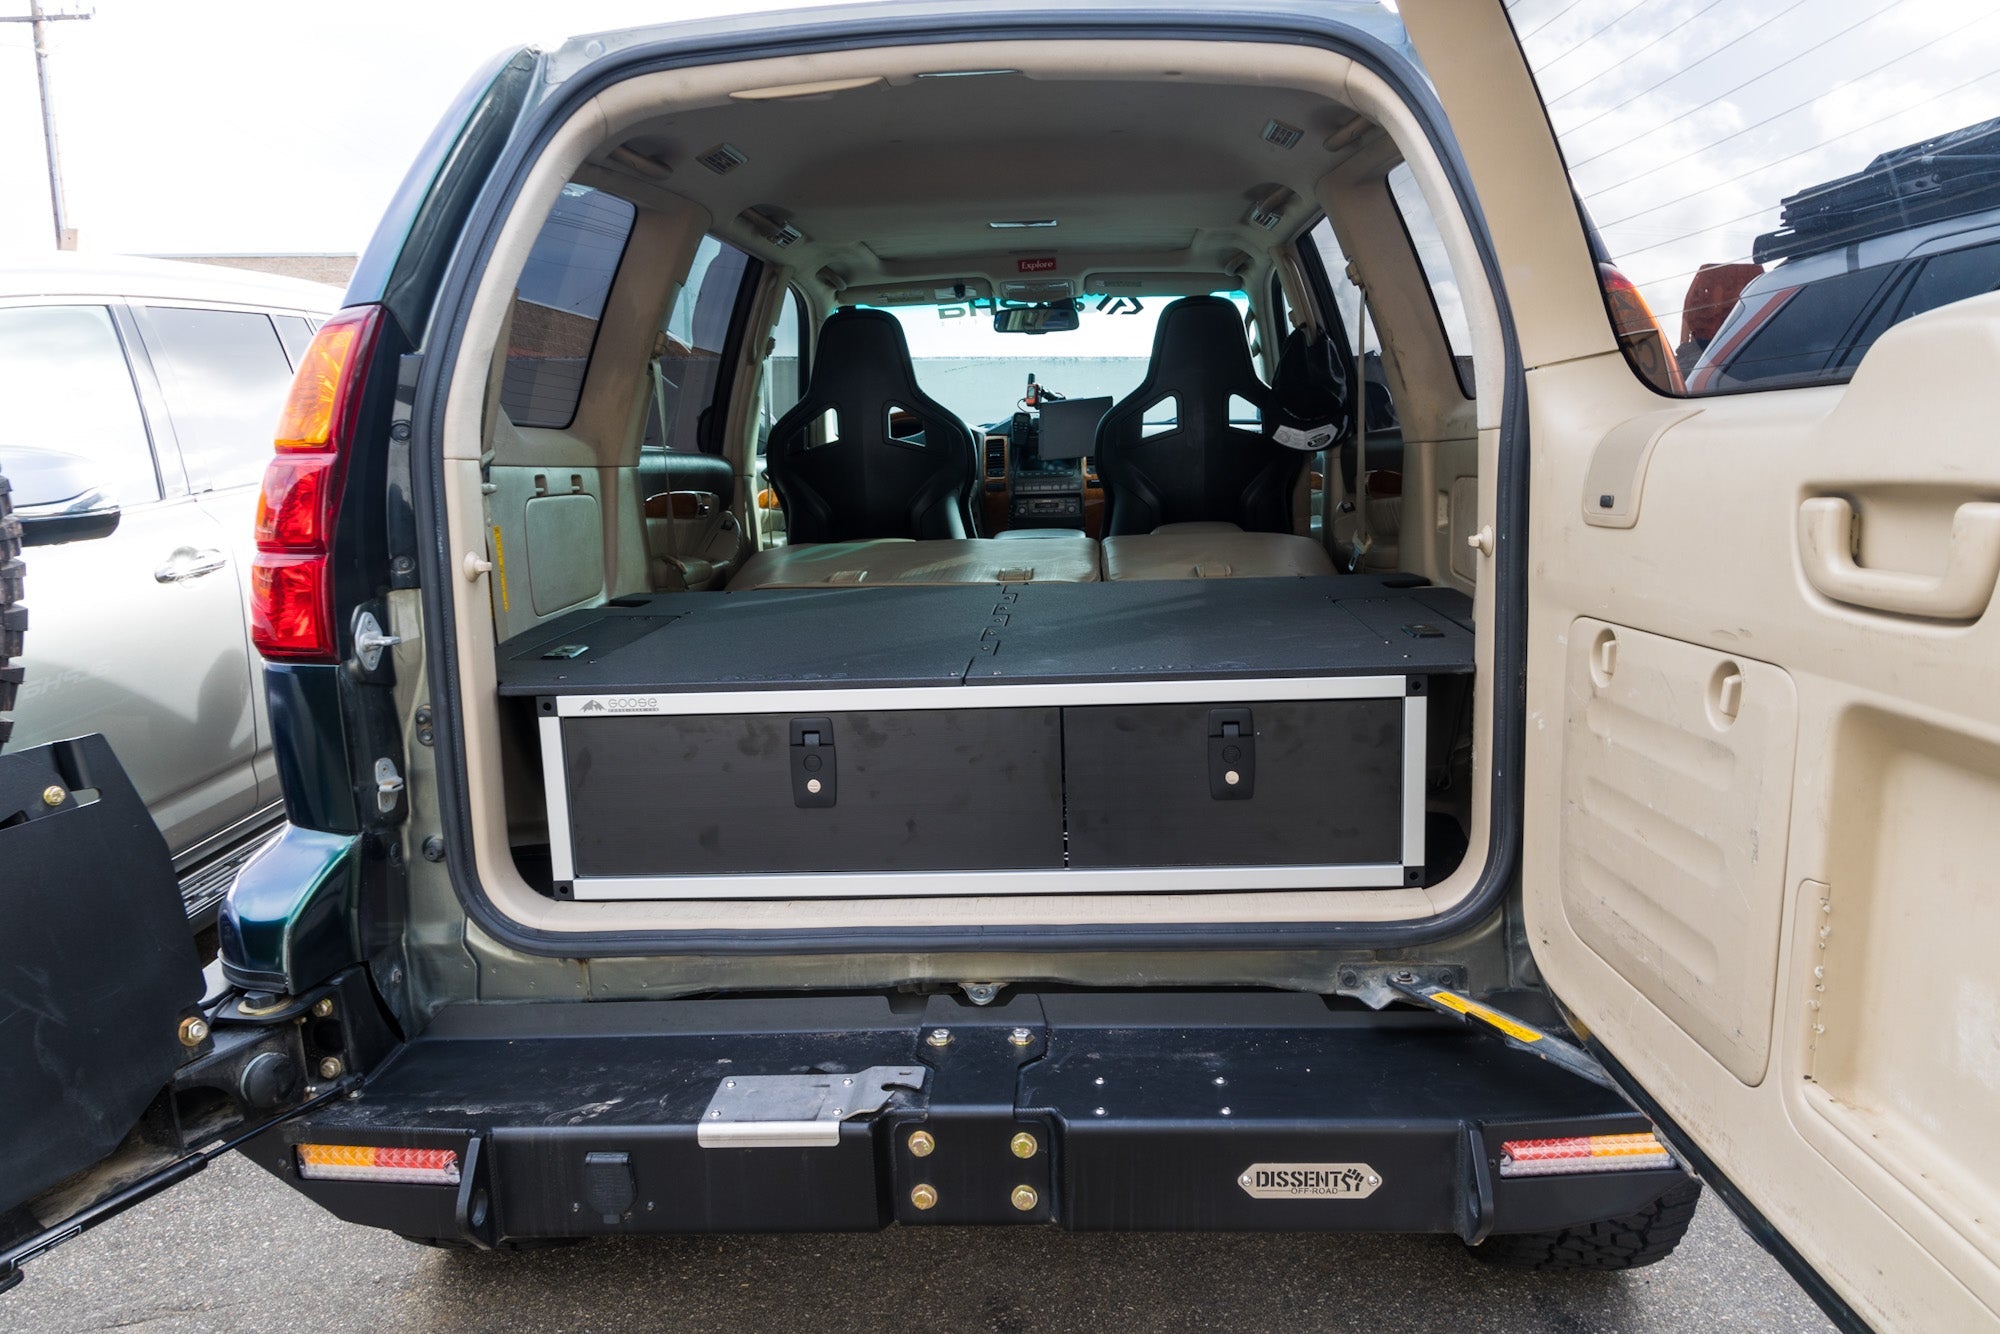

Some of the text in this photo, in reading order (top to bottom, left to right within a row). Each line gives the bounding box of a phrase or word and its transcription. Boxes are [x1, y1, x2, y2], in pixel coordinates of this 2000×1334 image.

[1021, 260, 1054, 271] Explore
[1256, 1171, 1342, 1187] DISSENT
[1290, 1187, 1338, 1195] OFF-ROAD
